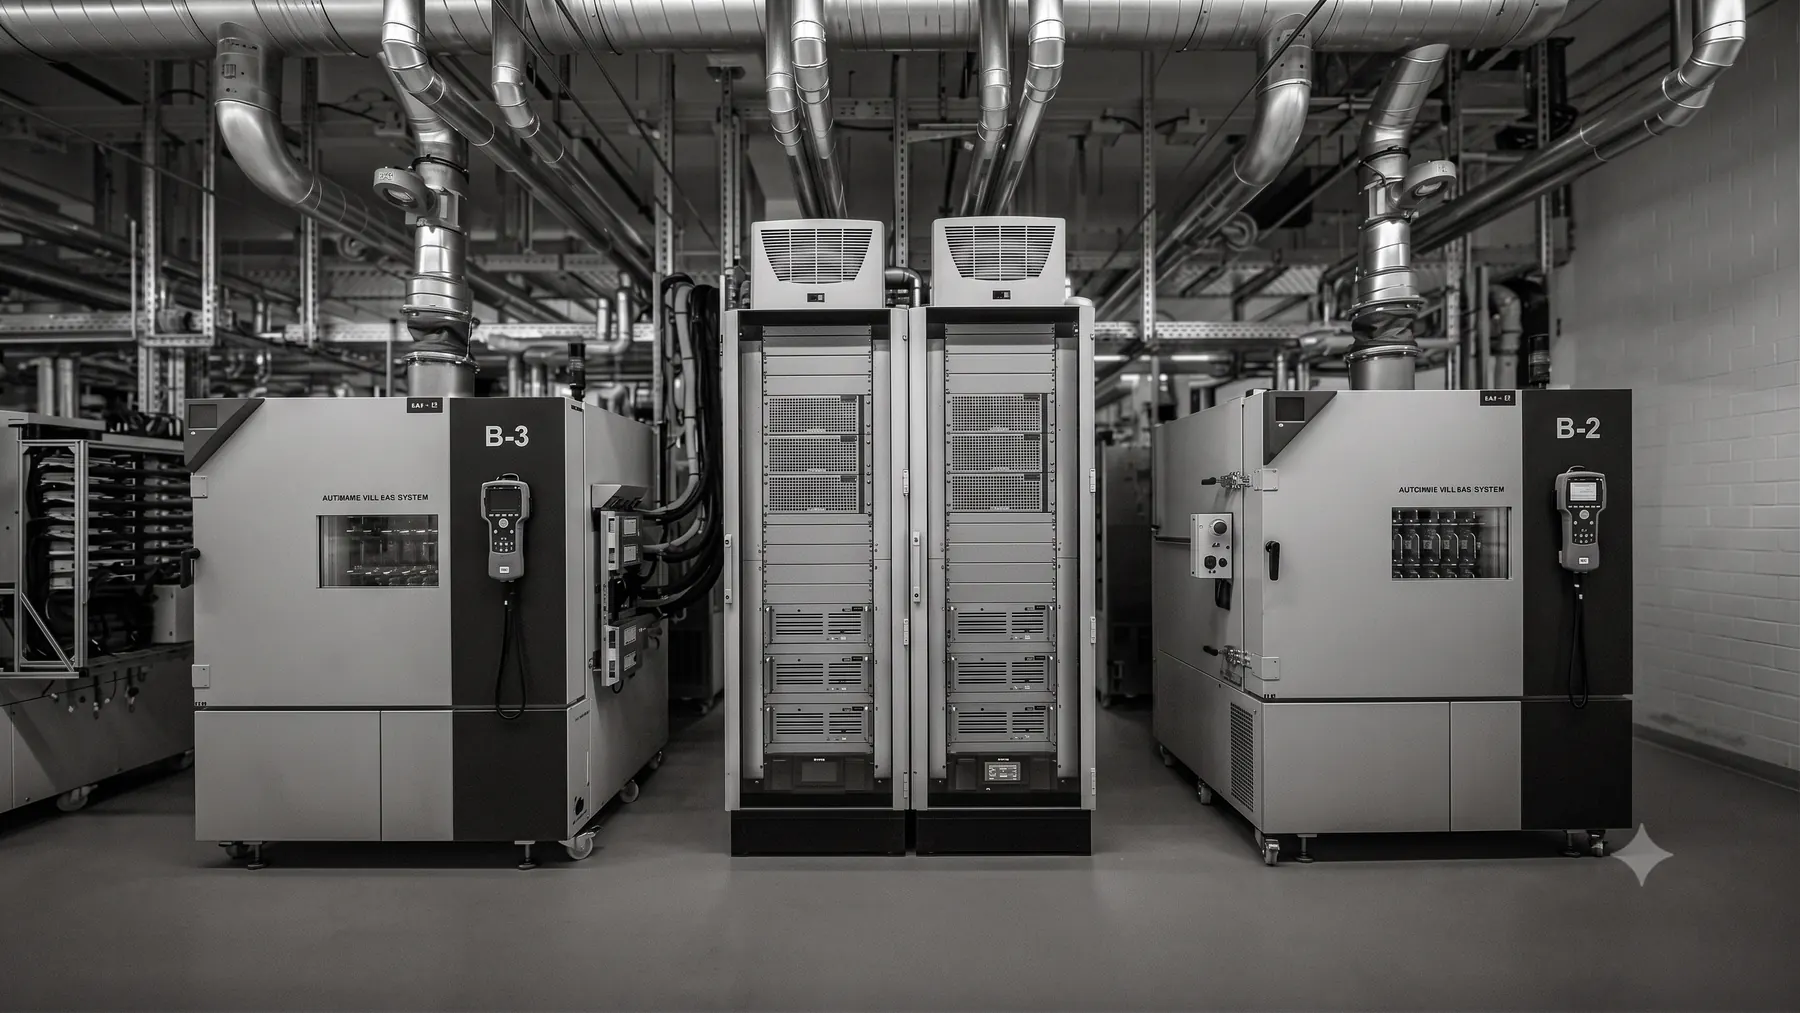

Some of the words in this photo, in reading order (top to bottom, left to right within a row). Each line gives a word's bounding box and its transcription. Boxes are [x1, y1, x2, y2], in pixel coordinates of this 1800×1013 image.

[1556, 416, 1600, 439] B-2
[485, 424, 530, 447] B-3
[1474, 485, 1505, 493] SYSTEM
[397, 493, 429, 501] SYSTEM
